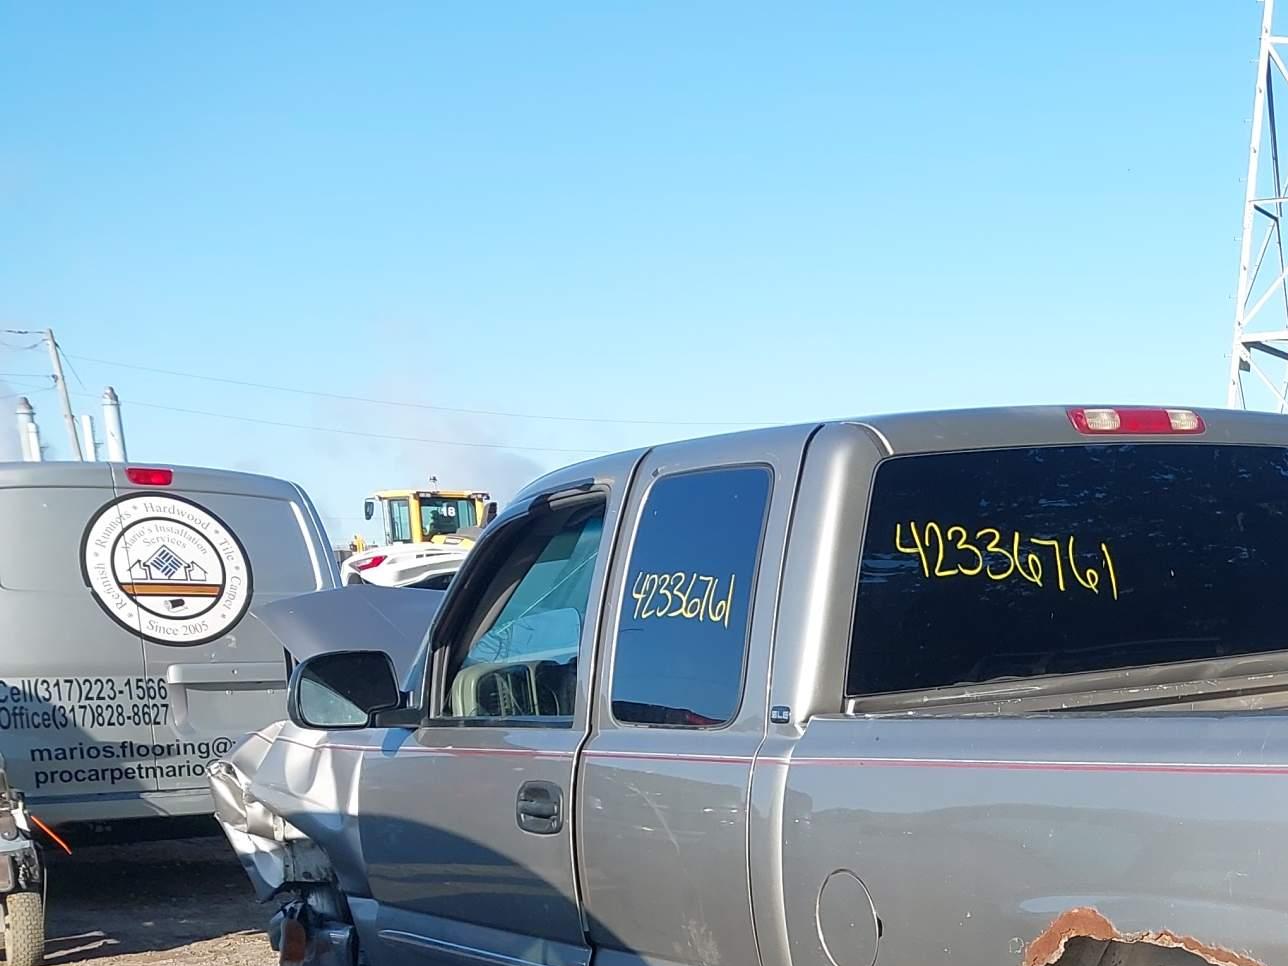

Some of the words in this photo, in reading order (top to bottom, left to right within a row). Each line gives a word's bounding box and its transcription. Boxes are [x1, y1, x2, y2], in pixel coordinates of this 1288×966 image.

[144, 502, 211, 531] Hardwood
[142, 534, 188, 550] Services
[154, 523, 209, 556] Installation
[218, 537, 236, 562] Tile
[894, 520, 1120, 600] 42336761
[221, 574, 242, 611] Carpet
[631, 570, 736, 630] 42336761
[146, 619, 179, 636] Since
[183, 620, 209, 636] 2005
[31, 736, 236, 762] marios.flooring@
